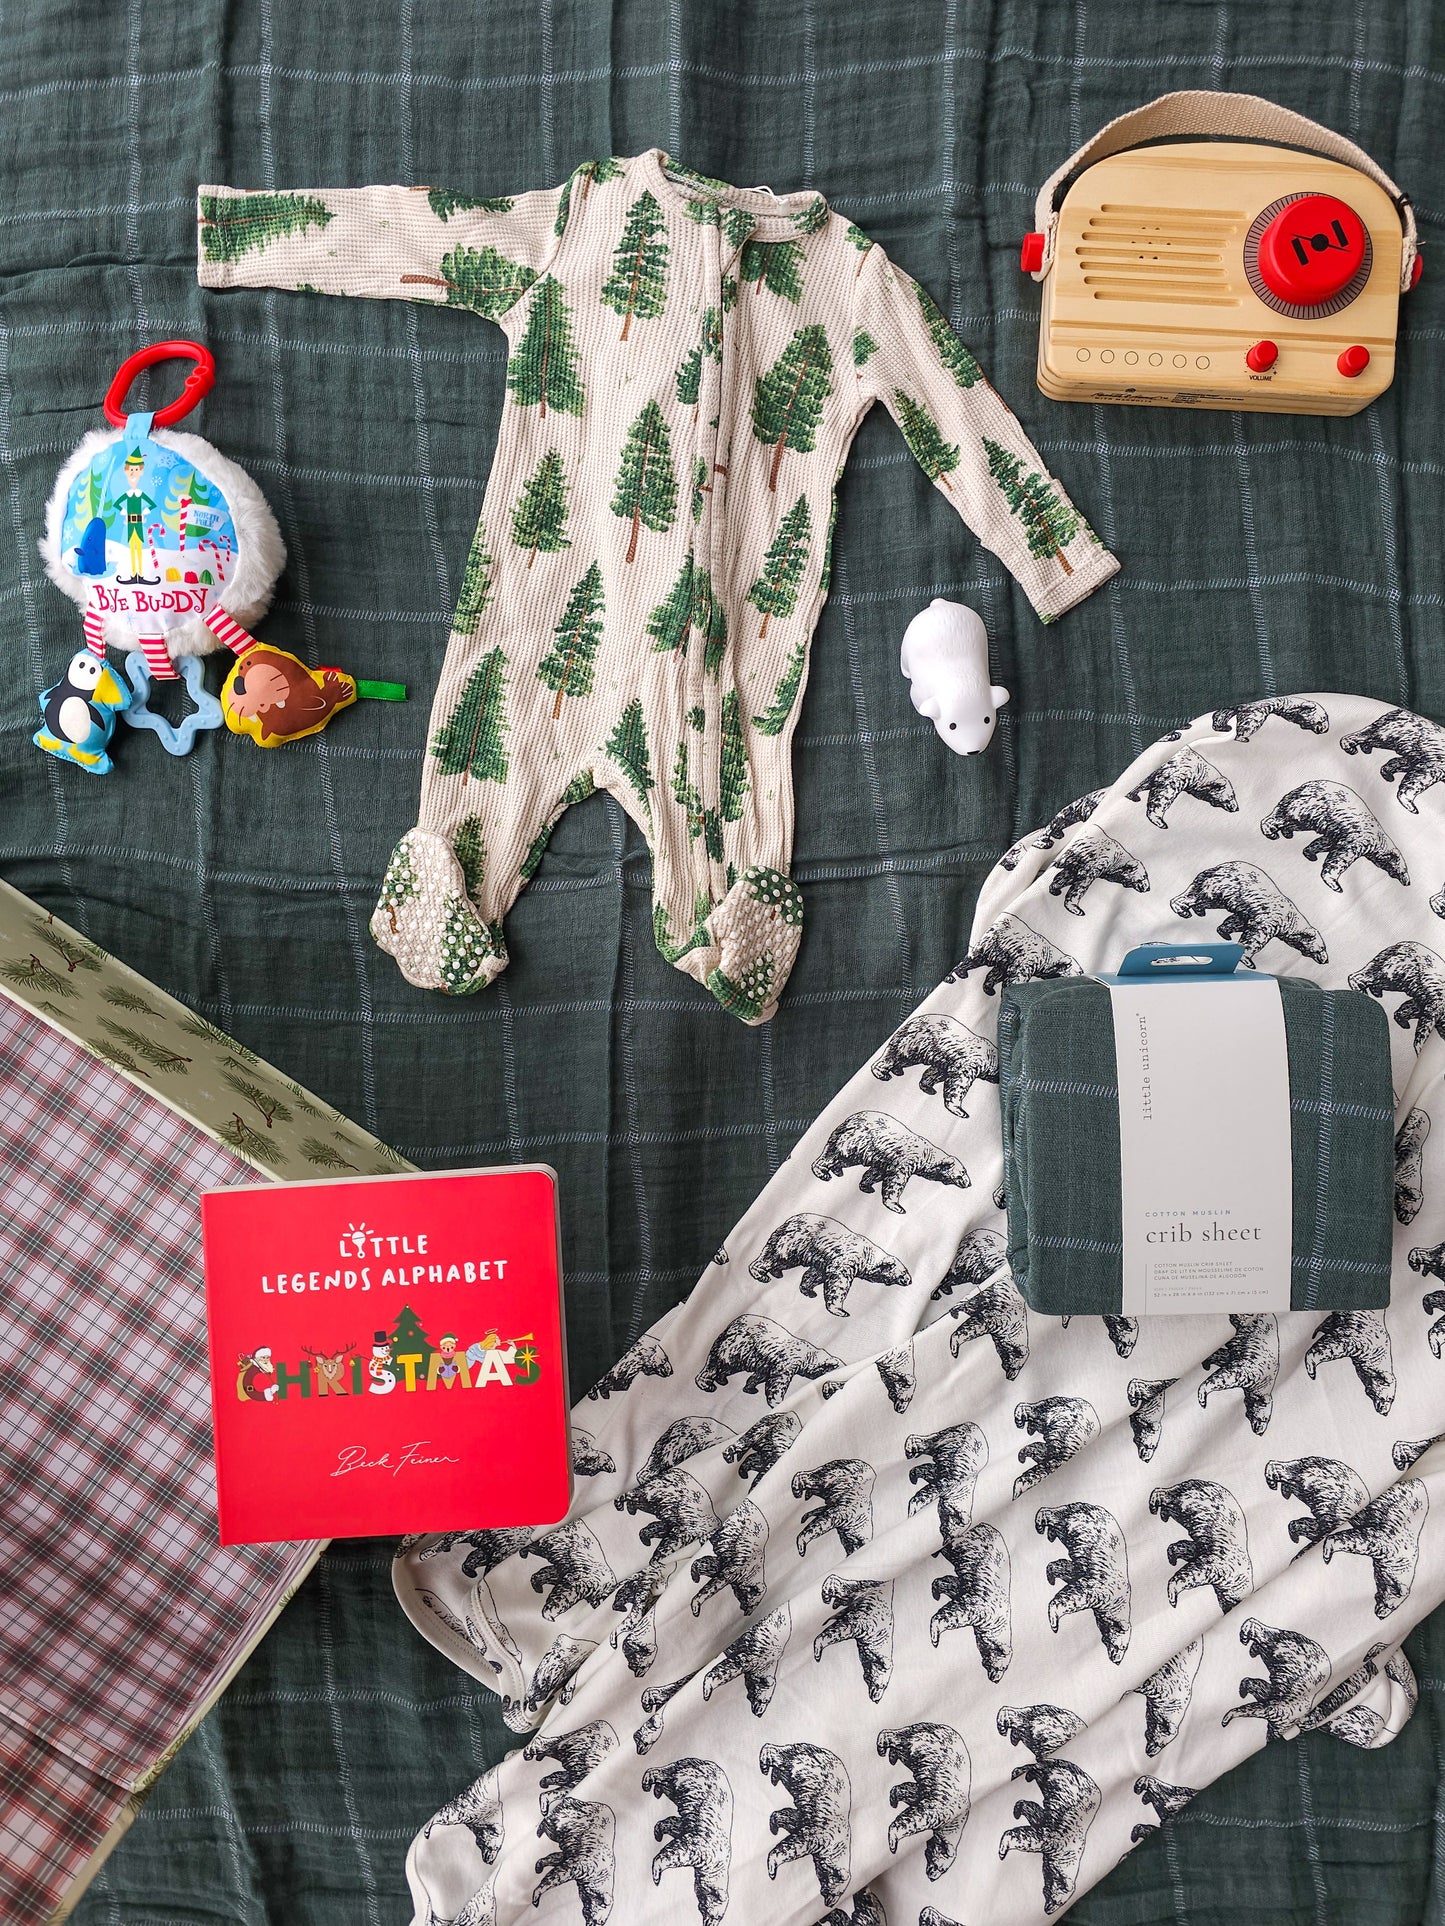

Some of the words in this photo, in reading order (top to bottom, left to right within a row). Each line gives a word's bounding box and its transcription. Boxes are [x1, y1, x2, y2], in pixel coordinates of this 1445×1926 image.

[194, 510, 220, 522] NORTH
[196, 518, 214, 527] POLE
[132, 588, 208, 613] BUDDY
[1142, 1077, 1152, 1120] little
[1146, 1222, 1192, 1243] crib
[1202, 1222, 1262, 1241] sheet
[262, 1267, 370, 1294] LEGENDS
[382, 1260, 508, 1286] ALPHABET
[236, 1338, 541, 1402] CHRISTMAS
[330, 1445, 394, 1478] Beck
[392, 1441, 460, 1477] Feiner
